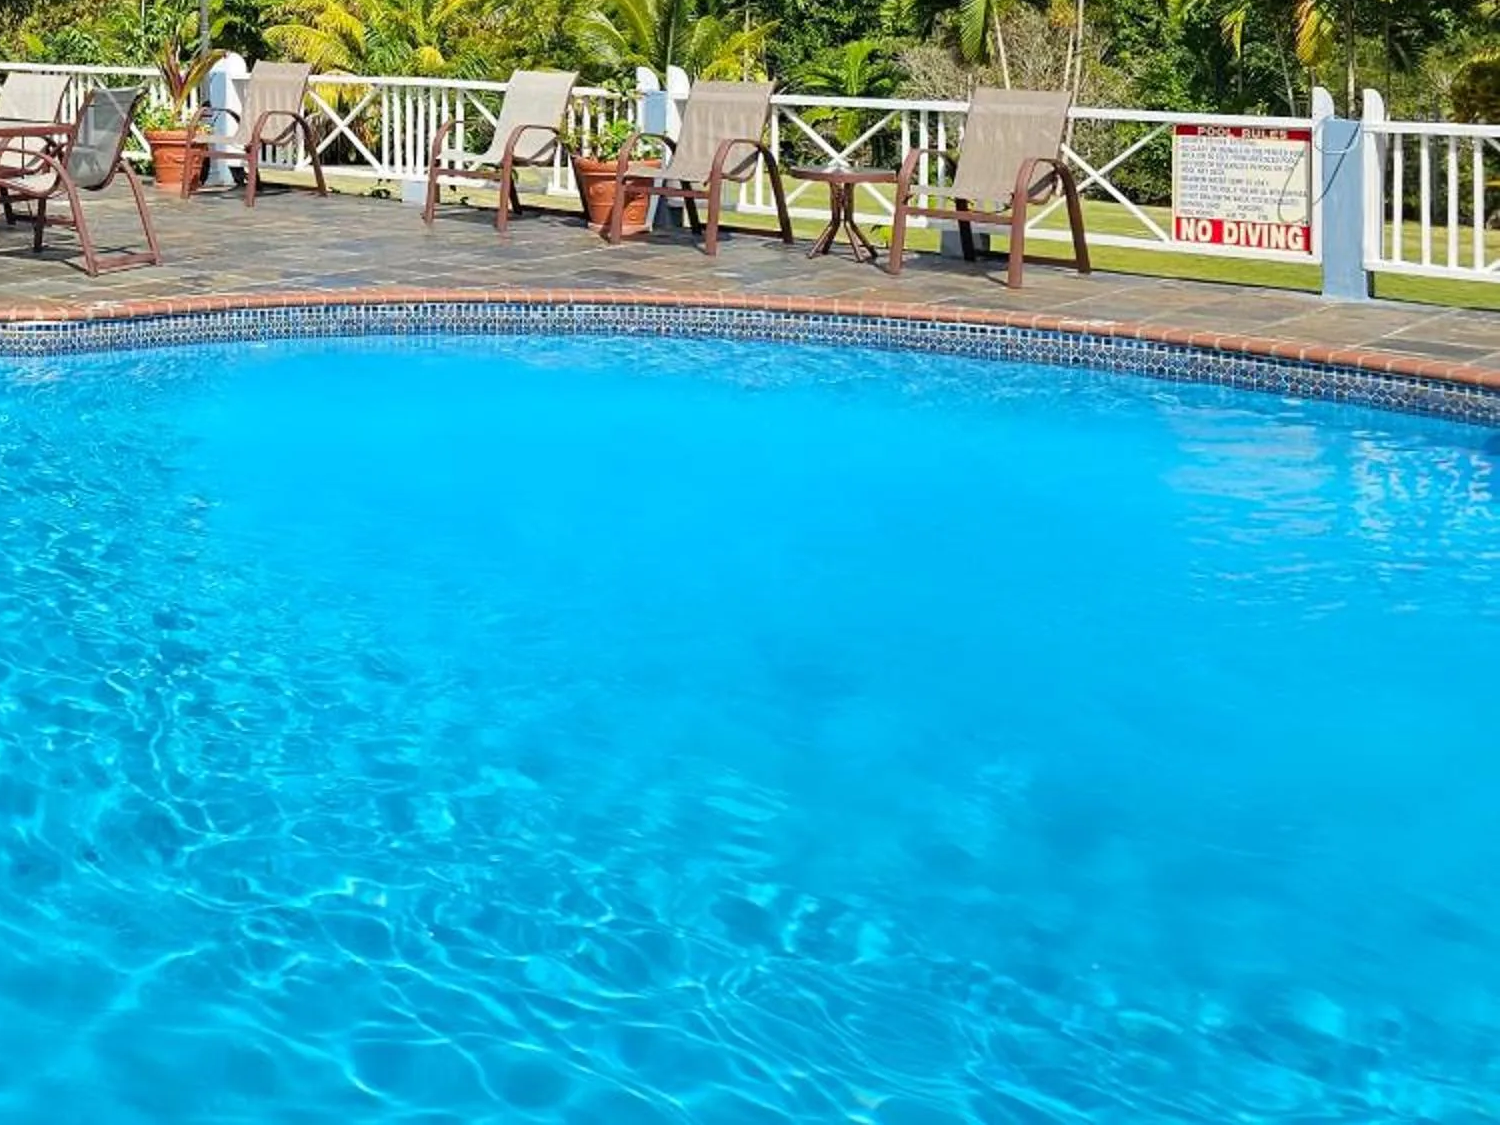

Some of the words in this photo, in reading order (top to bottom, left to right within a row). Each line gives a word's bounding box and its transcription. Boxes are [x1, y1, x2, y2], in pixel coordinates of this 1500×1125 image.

[1197, 126, 1234, 137] POOL
[1242, 129, 1287, 140] RULES
[1181, 218, 1213, 242] NO
[1222, 221, 1304, 251] DIVING
